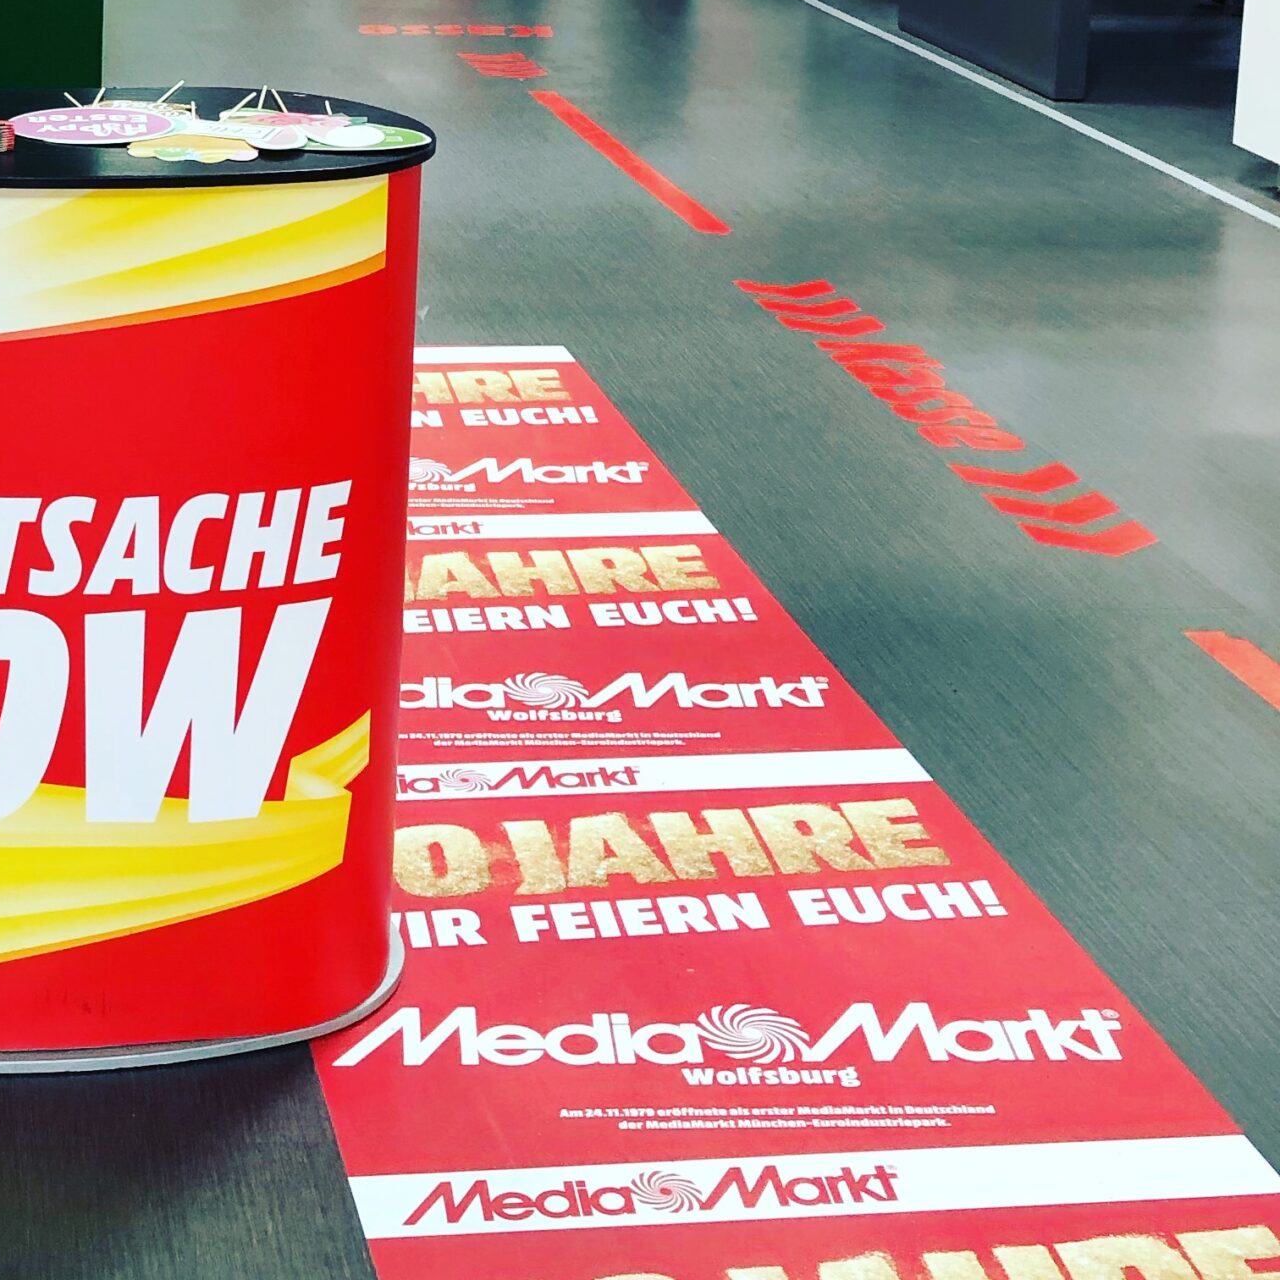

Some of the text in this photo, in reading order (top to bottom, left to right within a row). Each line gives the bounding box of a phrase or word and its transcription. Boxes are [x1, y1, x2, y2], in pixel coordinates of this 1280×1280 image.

[462, 406, 599, 427] EUCH!
[445, 457, 647, 483] Markt
[404, 544, 720, 603] AHRE
[403, 597, 758, 634] EIERN EUCH!
[399, 672, 829, 709] dia Markt
[487, 710, 623, 722] Wolfsburg
[489, 765, 640, 791] Markt
[500, 798, 952, 895] JAHRE
[511, 893, 770, 943] FEIERN
[789, 879, 1008, 927] EUCH!
[332, 1002, 1122, 1069] Media Markt
[681, 1064, 862, 1088] Wolfsburg
[559, 1108, 583, 1118] Am
[656, 1106, 723, 1117] eröffnete
[724, 1106, 750, 1116] als
[752, 1106, 795, 1116] erster
[797, 1104, 886, 1116] MediaMarkt
[905, 1103, 996, 1115] Deutschland
[617, 1120, 643, 1130] der
[645, 1119, 736, 1130] MediaMarkt
[402, 1163, 899, 1227] Media Markt
